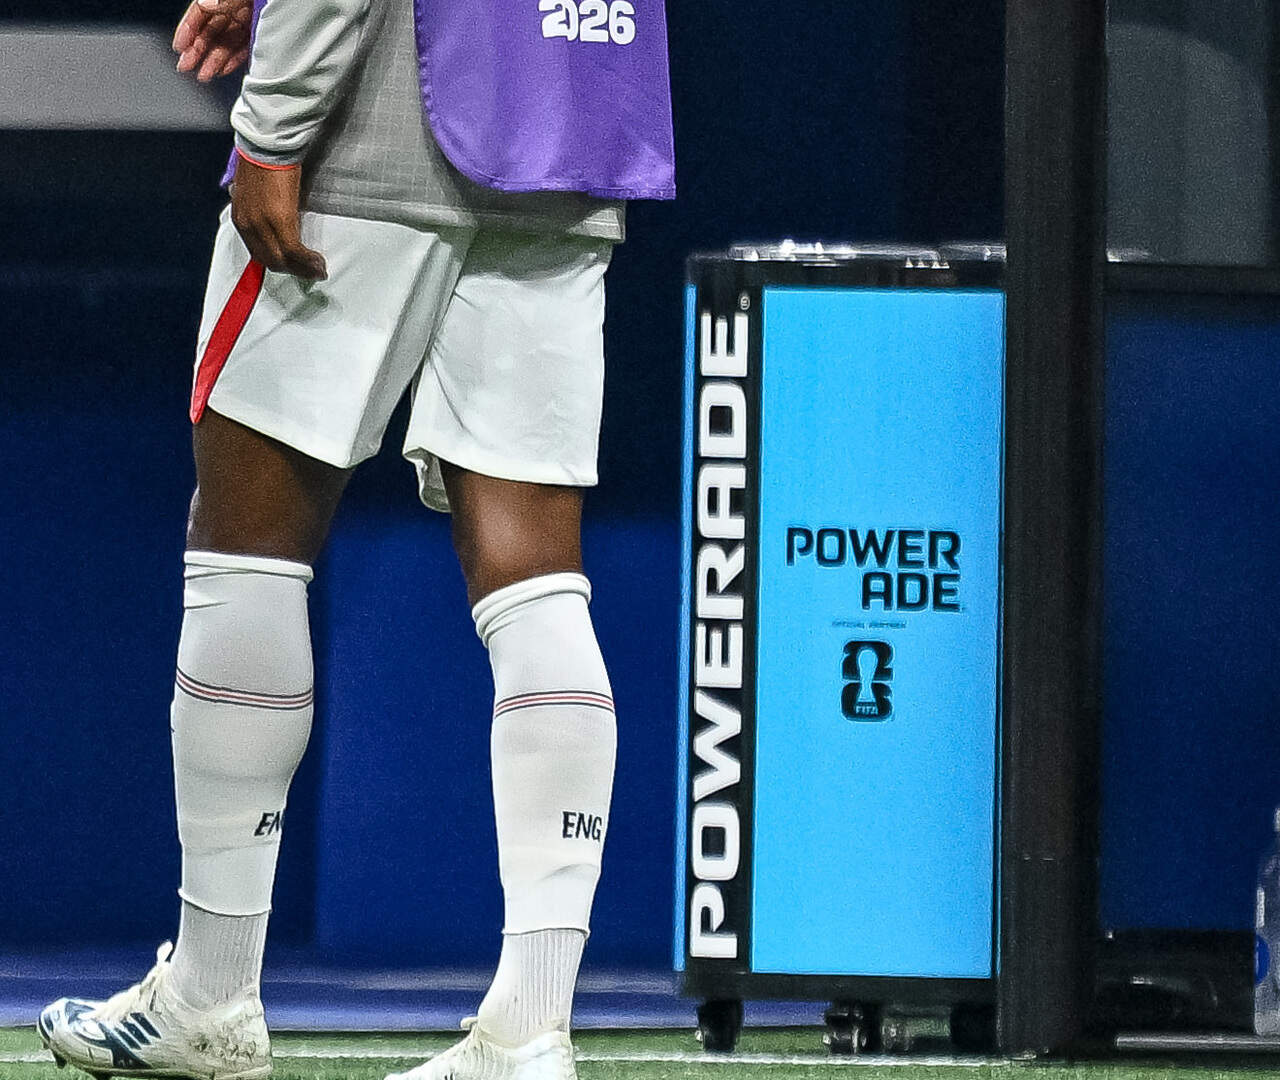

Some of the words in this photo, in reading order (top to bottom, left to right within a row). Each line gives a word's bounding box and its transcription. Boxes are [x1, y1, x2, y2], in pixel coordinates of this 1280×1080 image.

[786, 527, 961, 570] POWER
[861, 572, 961, 612] ADE
[690, 311, 749, 959] POWERADE
[562, 810, 603, 843] ENG
